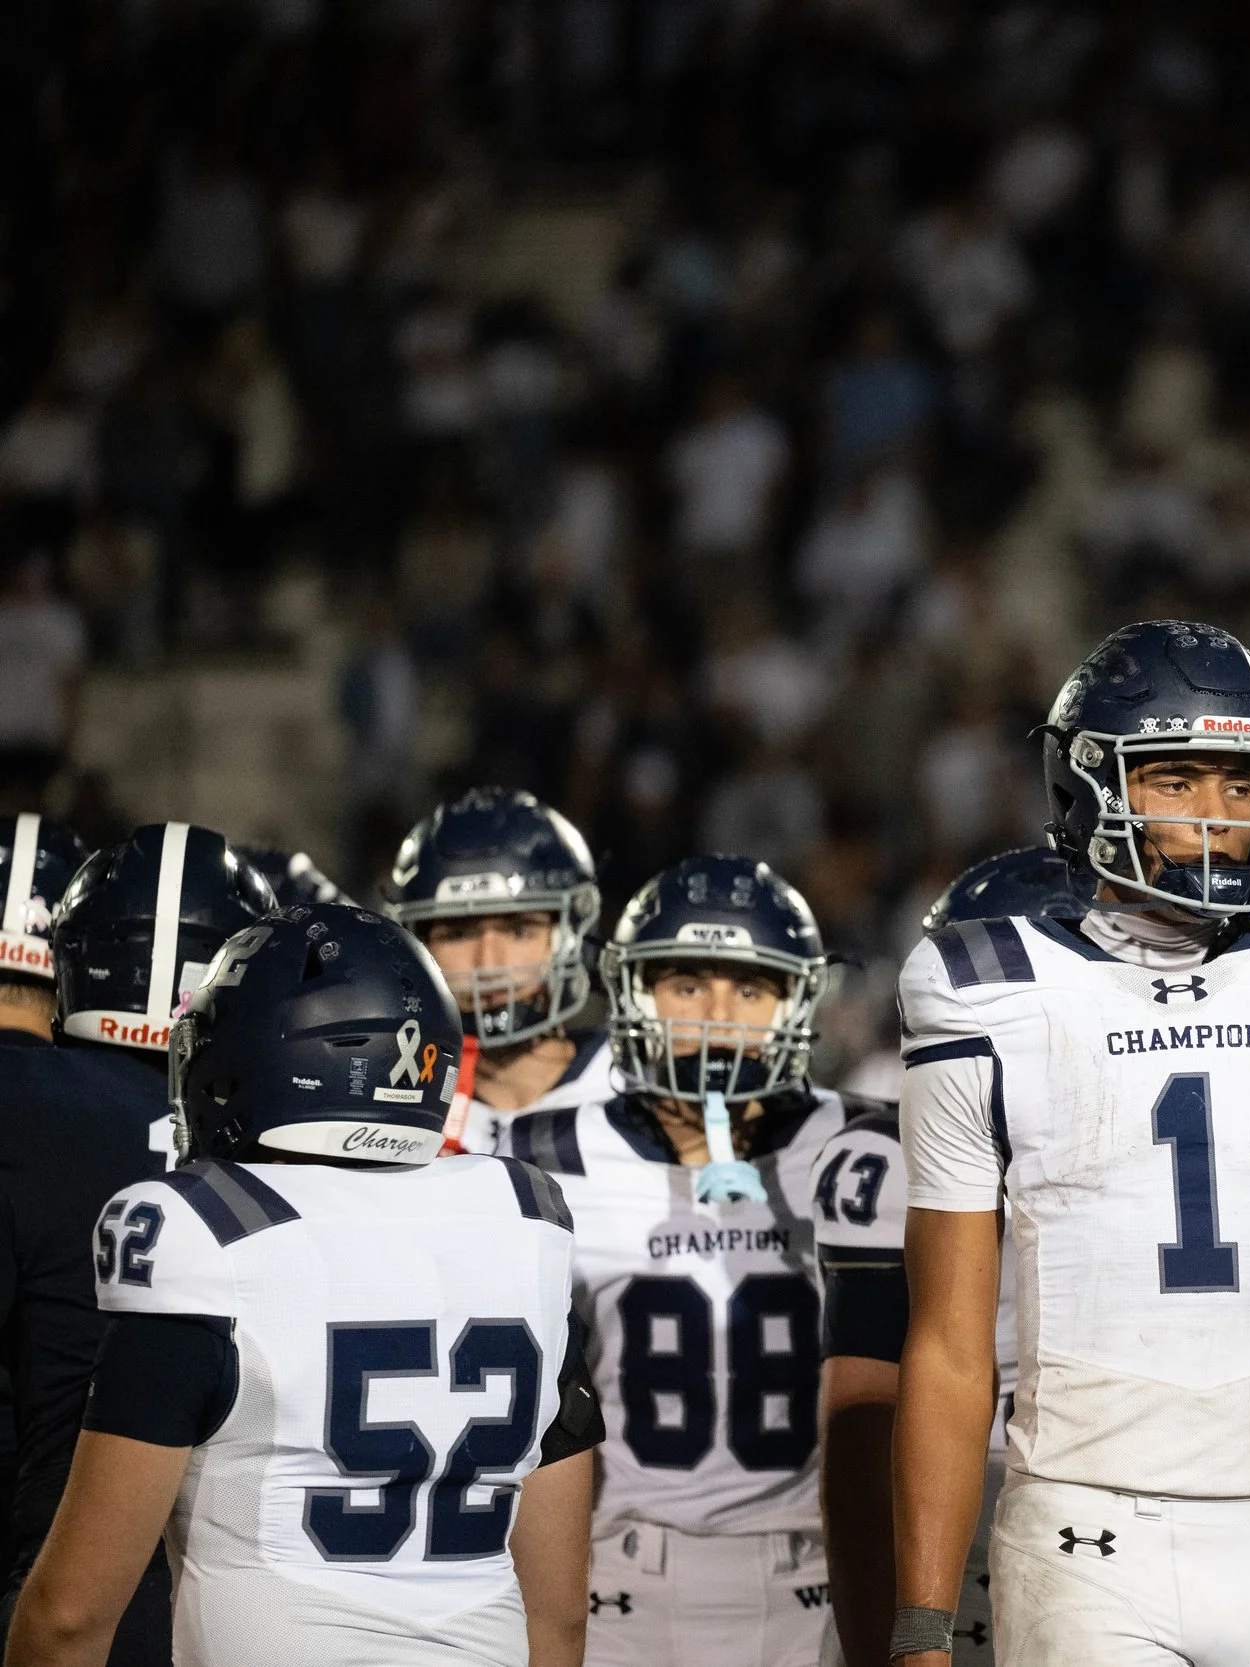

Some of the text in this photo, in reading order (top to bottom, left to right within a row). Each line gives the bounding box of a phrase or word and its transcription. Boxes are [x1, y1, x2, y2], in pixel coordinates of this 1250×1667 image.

[1211, 877, 1242, 887] Riddell
[100, 1017, 170, 1046] Ridd
[292, 1076, 323, 1087] Riddell
[813, 1148, 890, 1227] 43
[1151, 1072, 1240, 1294] 1
[97, 1199, 166, 1288] 52
[648, 1228, 791, 1259] CHAMPION
[616, 1273, 821, 1472] 88
[302, 1317, 544, 1562] 52
